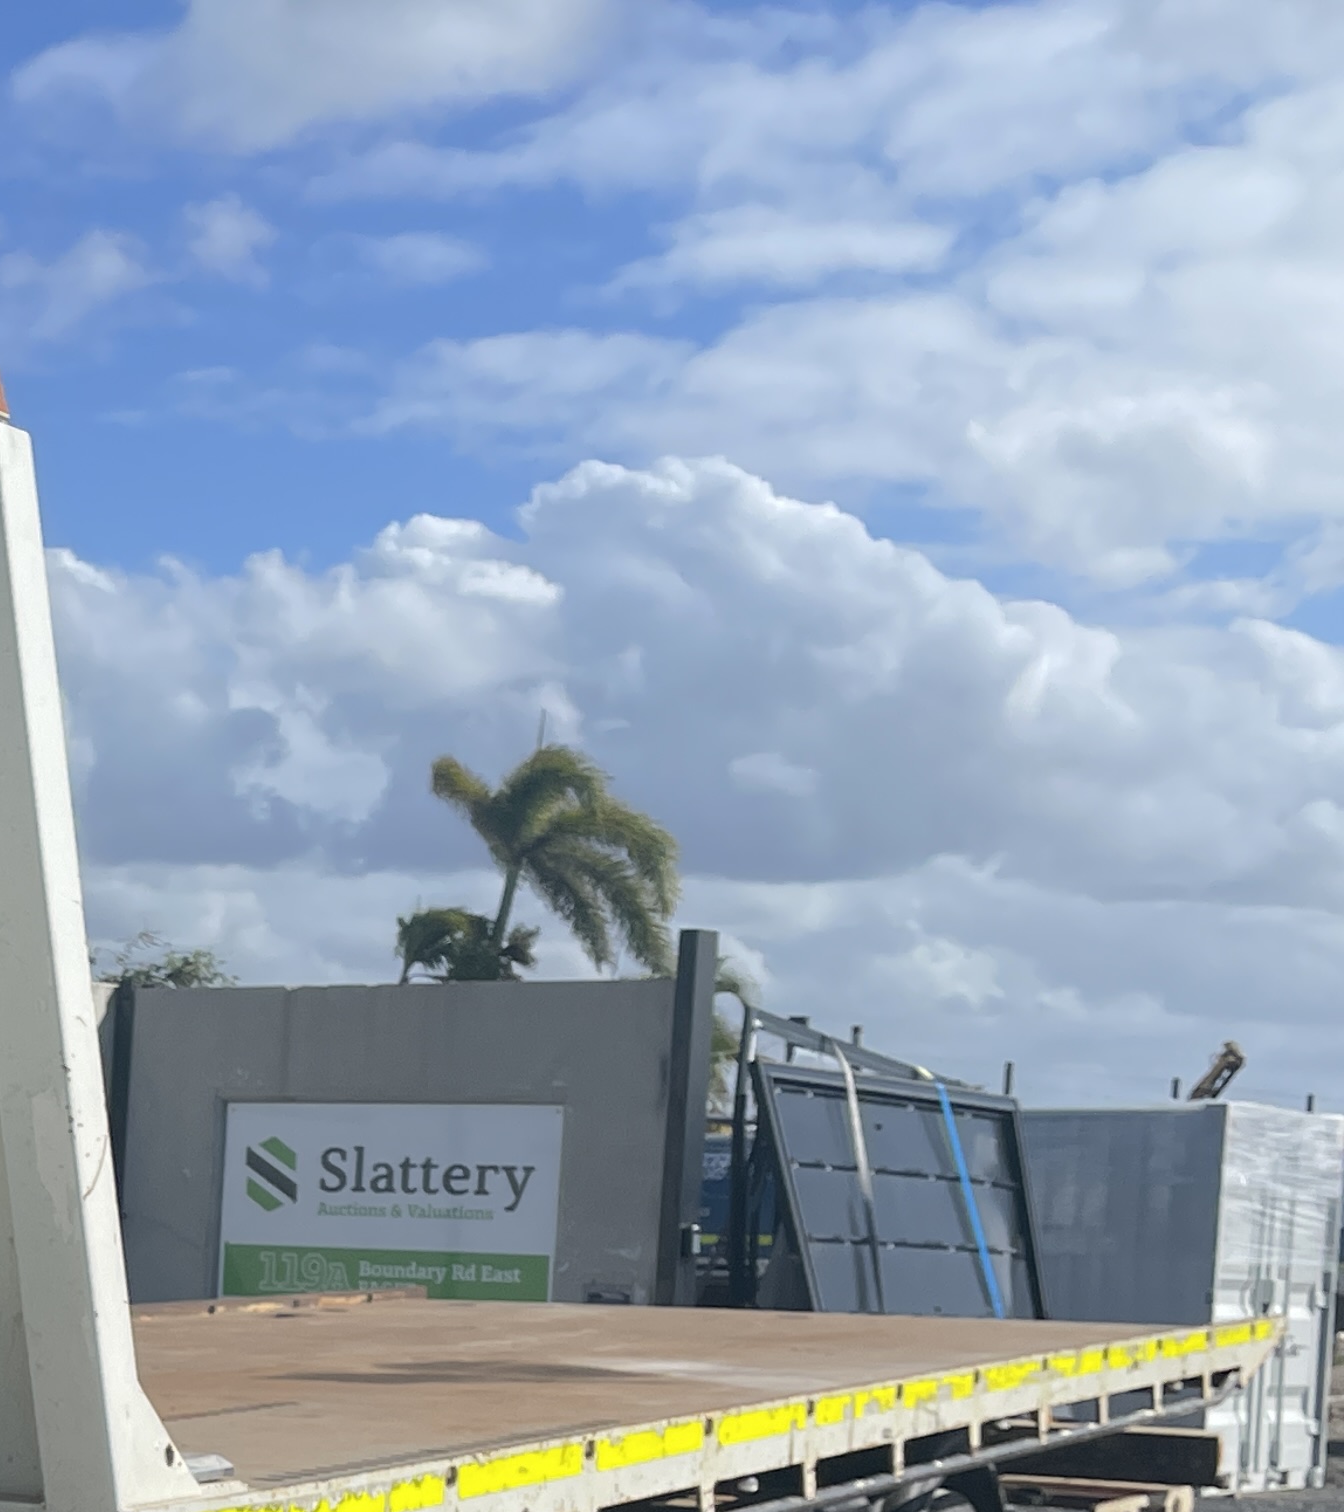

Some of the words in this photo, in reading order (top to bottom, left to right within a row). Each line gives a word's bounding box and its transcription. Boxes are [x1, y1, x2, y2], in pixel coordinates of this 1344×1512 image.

[319, 1146, 535, 1211] Slattery
[318, 1202, 387, 1218] Auctions
[390, 1205, 403, 1219] &
[408, 1204, 494, 1221] Valuations
[259, 1251, 351, 1291] 119A
[359, 1261, 447, 1284] Boundary
[452, 1264, 477, 1281] Rd
[481, 1265, 520, 1284] East
